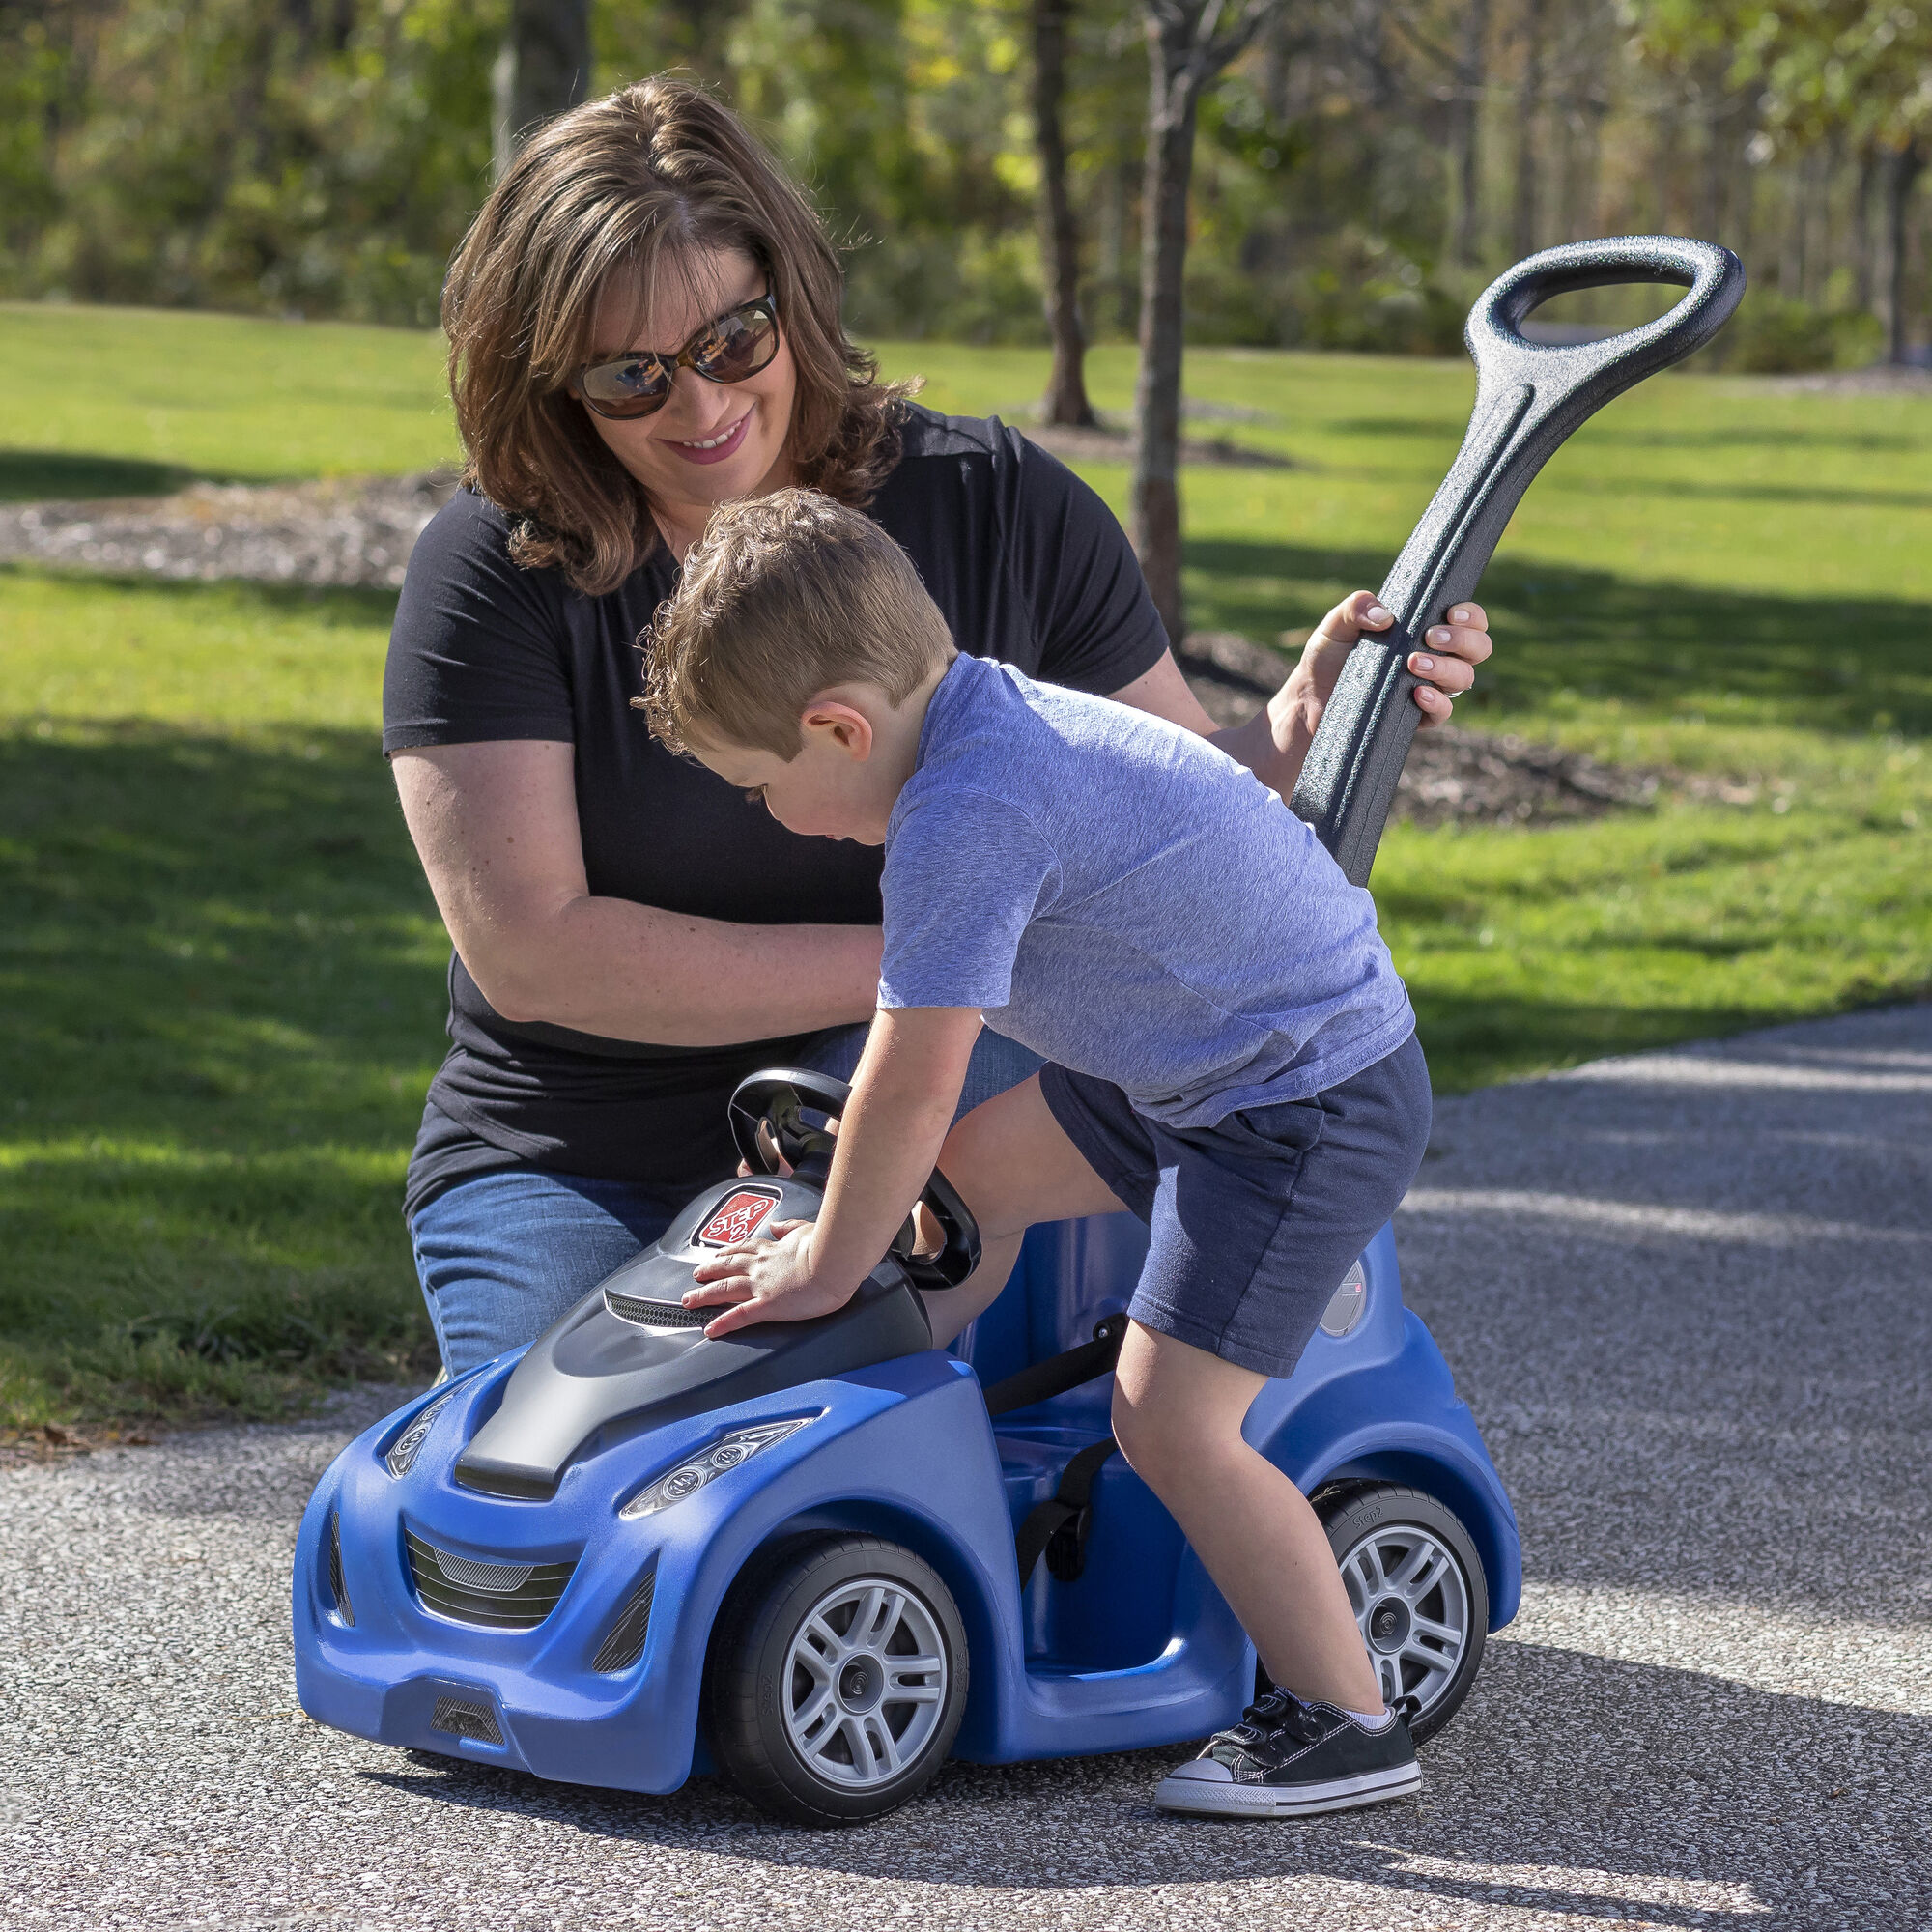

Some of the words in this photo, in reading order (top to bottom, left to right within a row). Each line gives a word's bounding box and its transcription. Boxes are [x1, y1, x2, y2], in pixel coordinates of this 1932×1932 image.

[708, 1199, 769, 1237] STEP
[729, 1222, 748, 1242] 2
[1353, 1507, 1383, 1529] Step2
